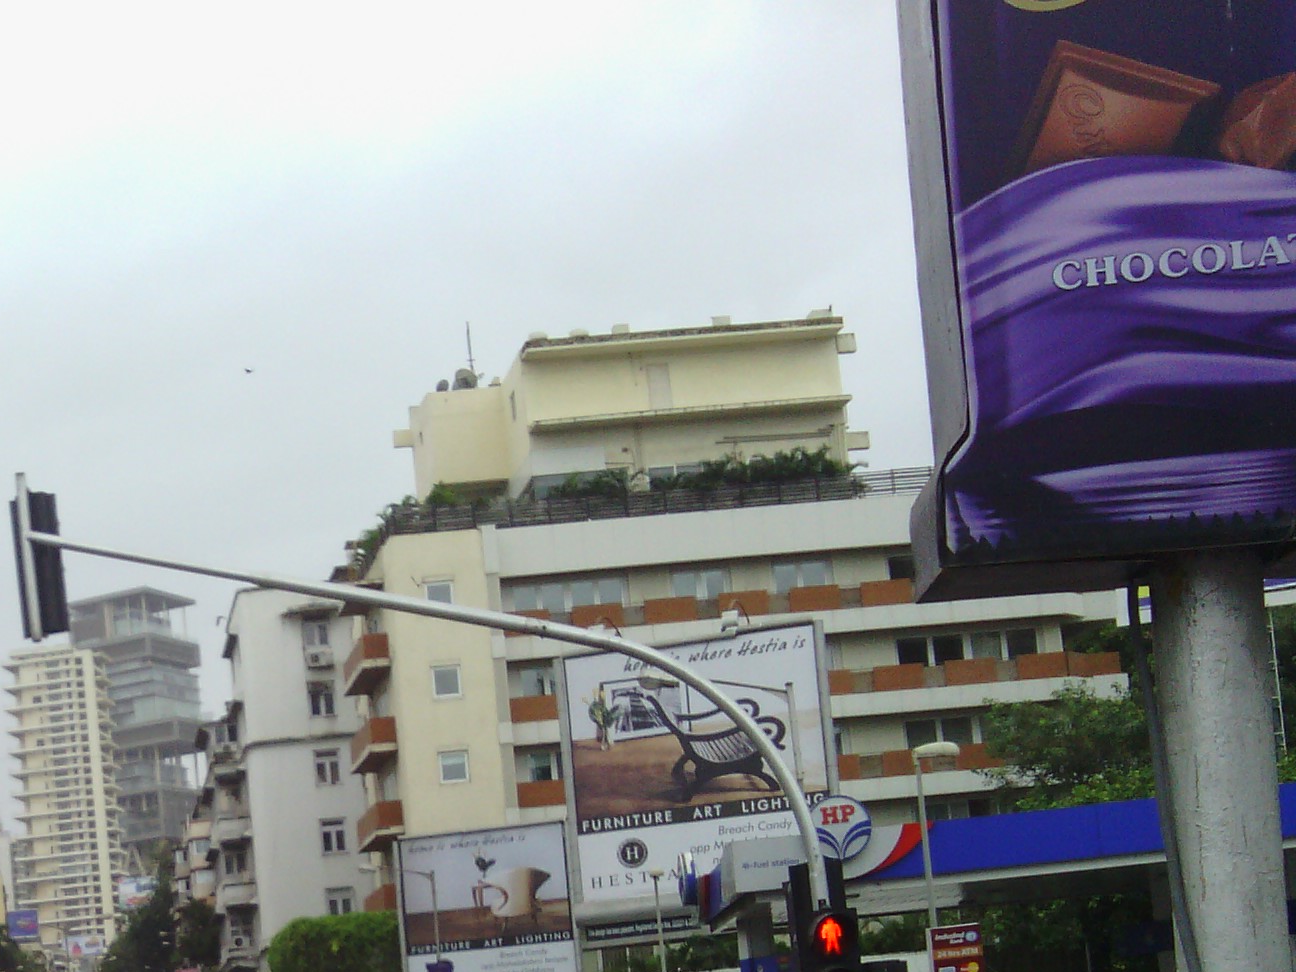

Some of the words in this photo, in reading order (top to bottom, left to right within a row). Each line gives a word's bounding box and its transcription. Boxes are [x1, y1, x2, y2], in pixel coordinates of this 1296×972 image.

[688, 641, 732, 663] where
[737, 637, 787, 658] Hestia
[793, 635, 806, 650] is
[582, 810, 673, 833] FURNITURE
[693, 804, 723, 820] ART
[741, 792, 825, 814] LIGHTNG
[820, 804, 855, 825] HP
[718, 822, 754, 836] Breach
[758, 818, 792, 832] Candy
[591, 867, 680, 889] HESTA
[484, 938, 503, 947] ART
[515, 931, 571, 944] LIGHTING
